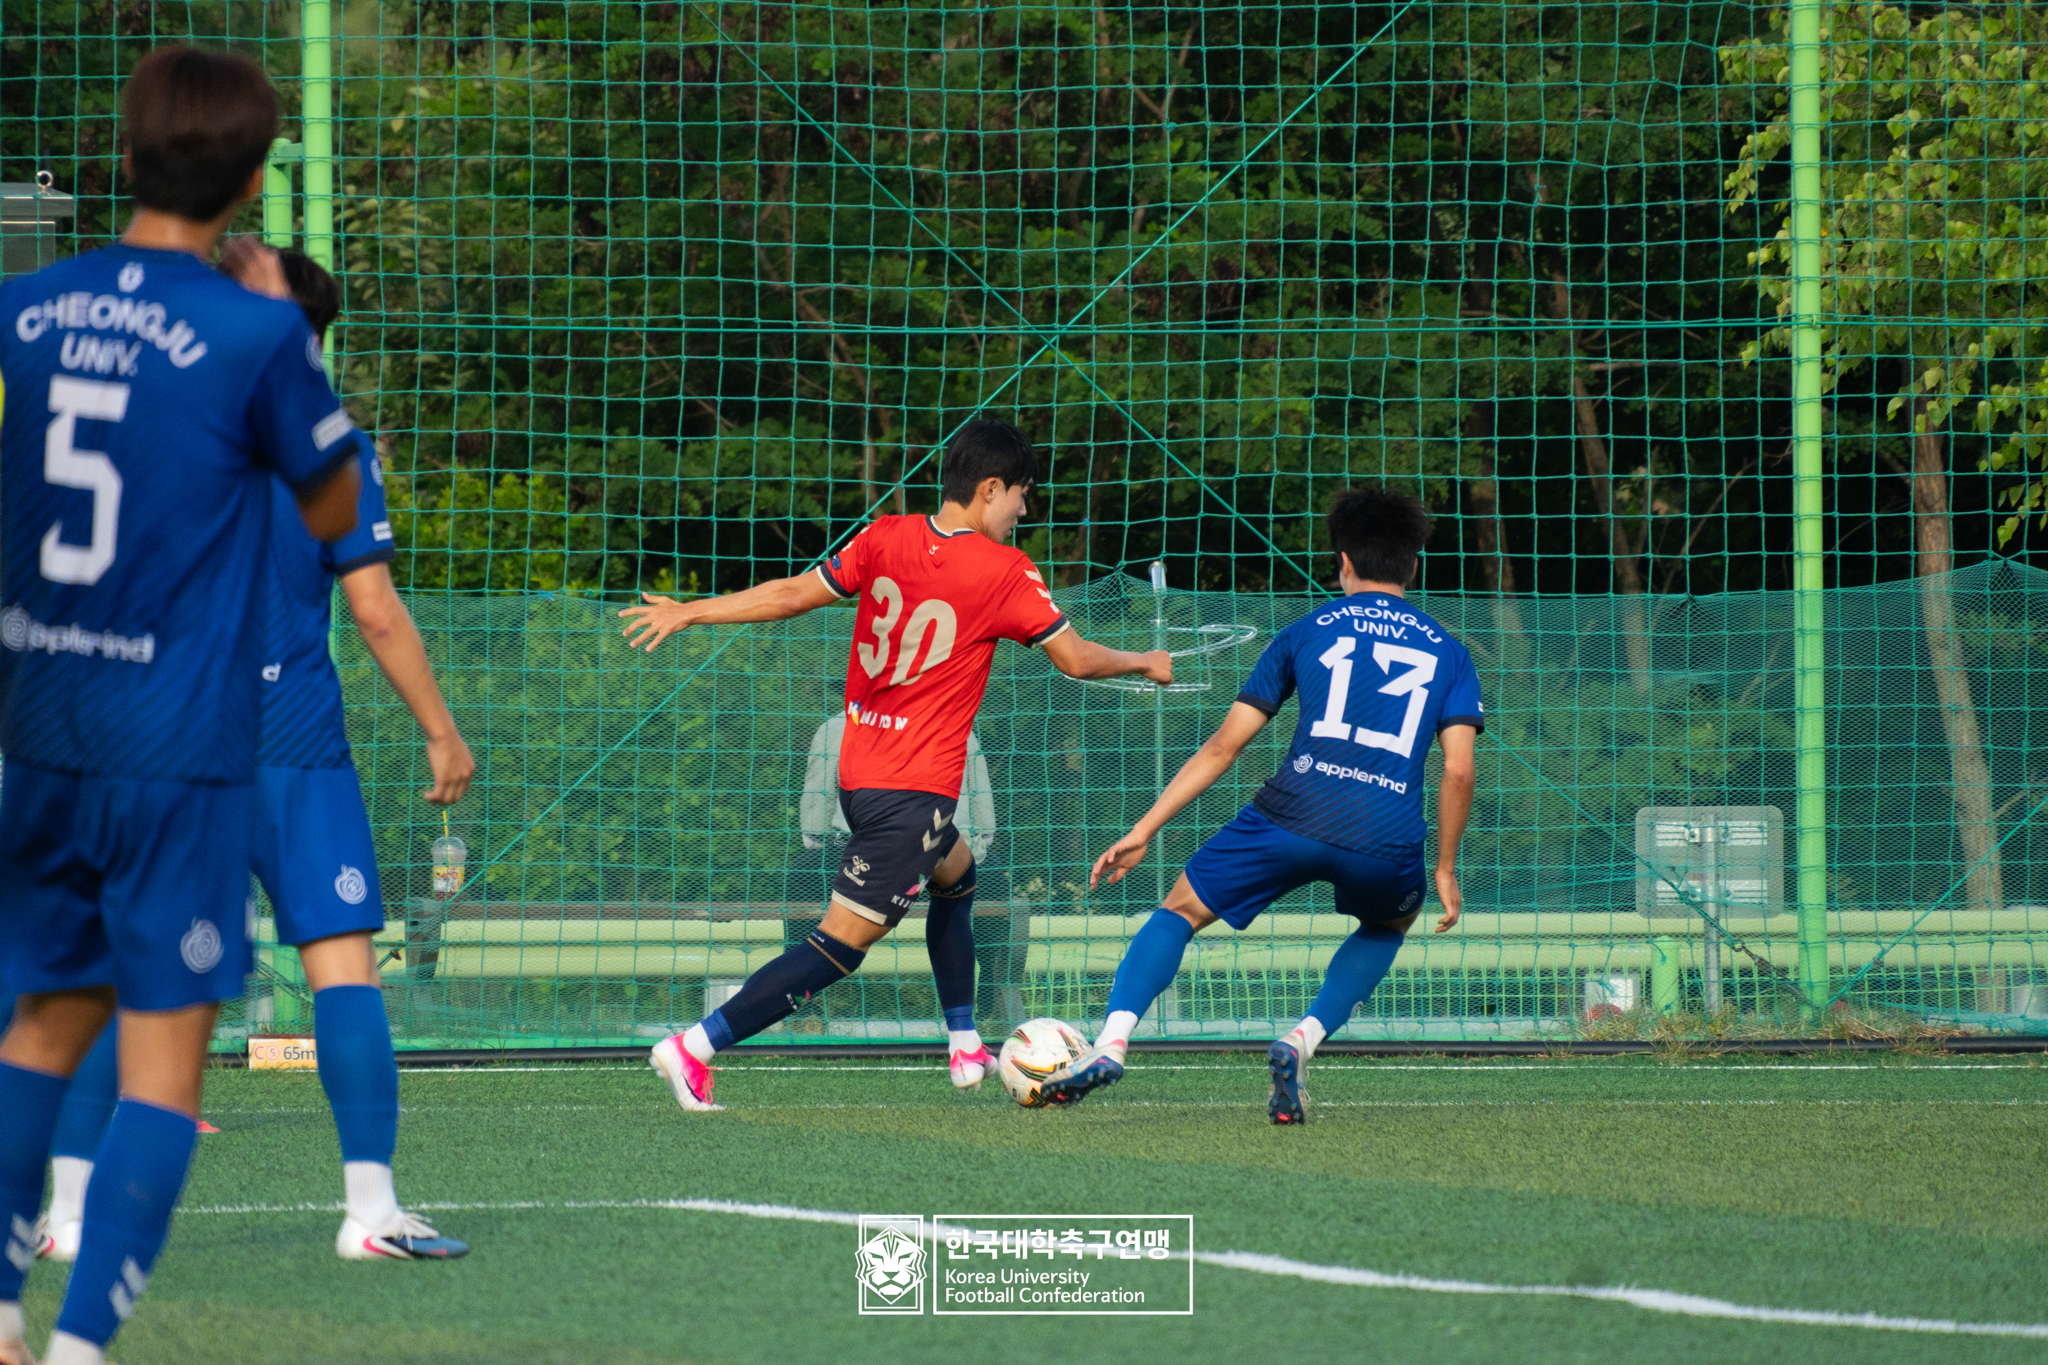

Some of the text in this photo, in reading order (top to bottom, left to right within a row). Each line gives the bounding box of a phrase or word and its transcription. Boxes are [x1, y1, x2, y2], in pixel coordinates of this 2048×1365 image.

[16, 291, 207, 369] CHEONGJU
[60, 331, 142, 376] UNIV.
[40, 373, 130, 586] 5
[858, 576, 957, 686] 30
[1316, 606, 1443, 644] CHEONGJU
[1353, 618, 1409, 640] UNIV.
[1310, 636, 1439, 759] 13
[1315, 760, 1407, 795] applerind
[283, 1046, 316, 1061] 65m
